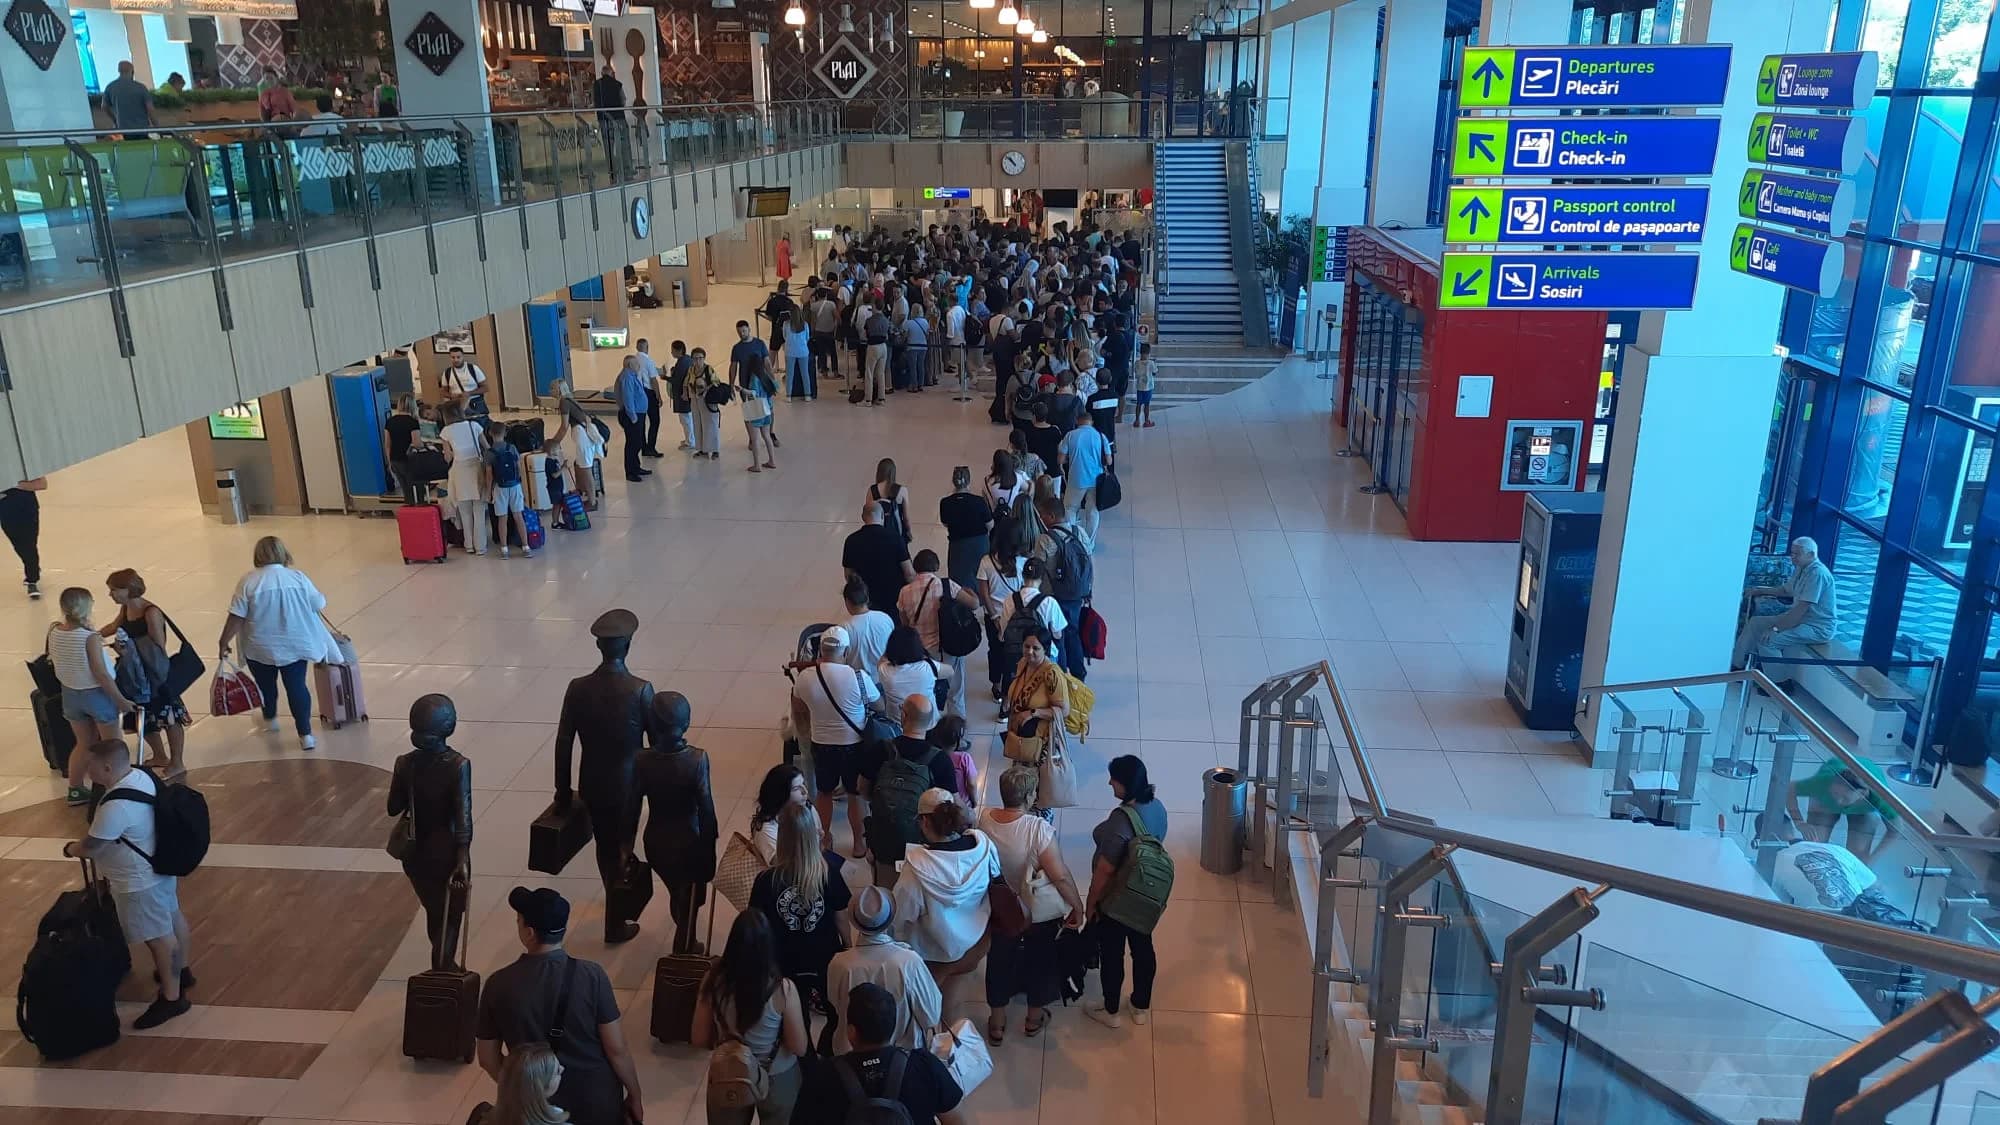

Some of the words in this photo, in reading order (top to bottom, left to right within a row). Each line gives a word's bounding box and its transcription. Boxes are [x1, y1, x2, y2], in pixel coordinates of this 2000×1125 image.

[19, 11, 56, 46] PLAI
[416, 32, 451, 57] PLAI
[831, 61, 857, 80] PLAI
[1568, 59, 1655, 77] Departures
[1797, 66, 1817, 80] Lounge
[1818, 67, 1833, 78] zone
[1565, 79, 1620, 95] Plecări
[1808, 83, 1829, 99] lounge
[1561, 130, 1628, 145] Check-in
[1786, 126, 1802, 139] Toilet
[1807, 127, 1819, 140] WC
[1558, 150, 1626, 165] Check-in
[1776, 185, 1794, 197] Mother
[1804, 189, 1817, 204] baby
[1817, 193, 1833, 203] room
[1553, 198, 1619, 216] Passport
[1623, 198, 1676, 213] control
[1550, 220, 1601, 233] Control
[1603, 219, 1621, 233] de
[1542, 265, 1600, 279] Arrivals
[1540, 284, 1583, 299] Sosiri
